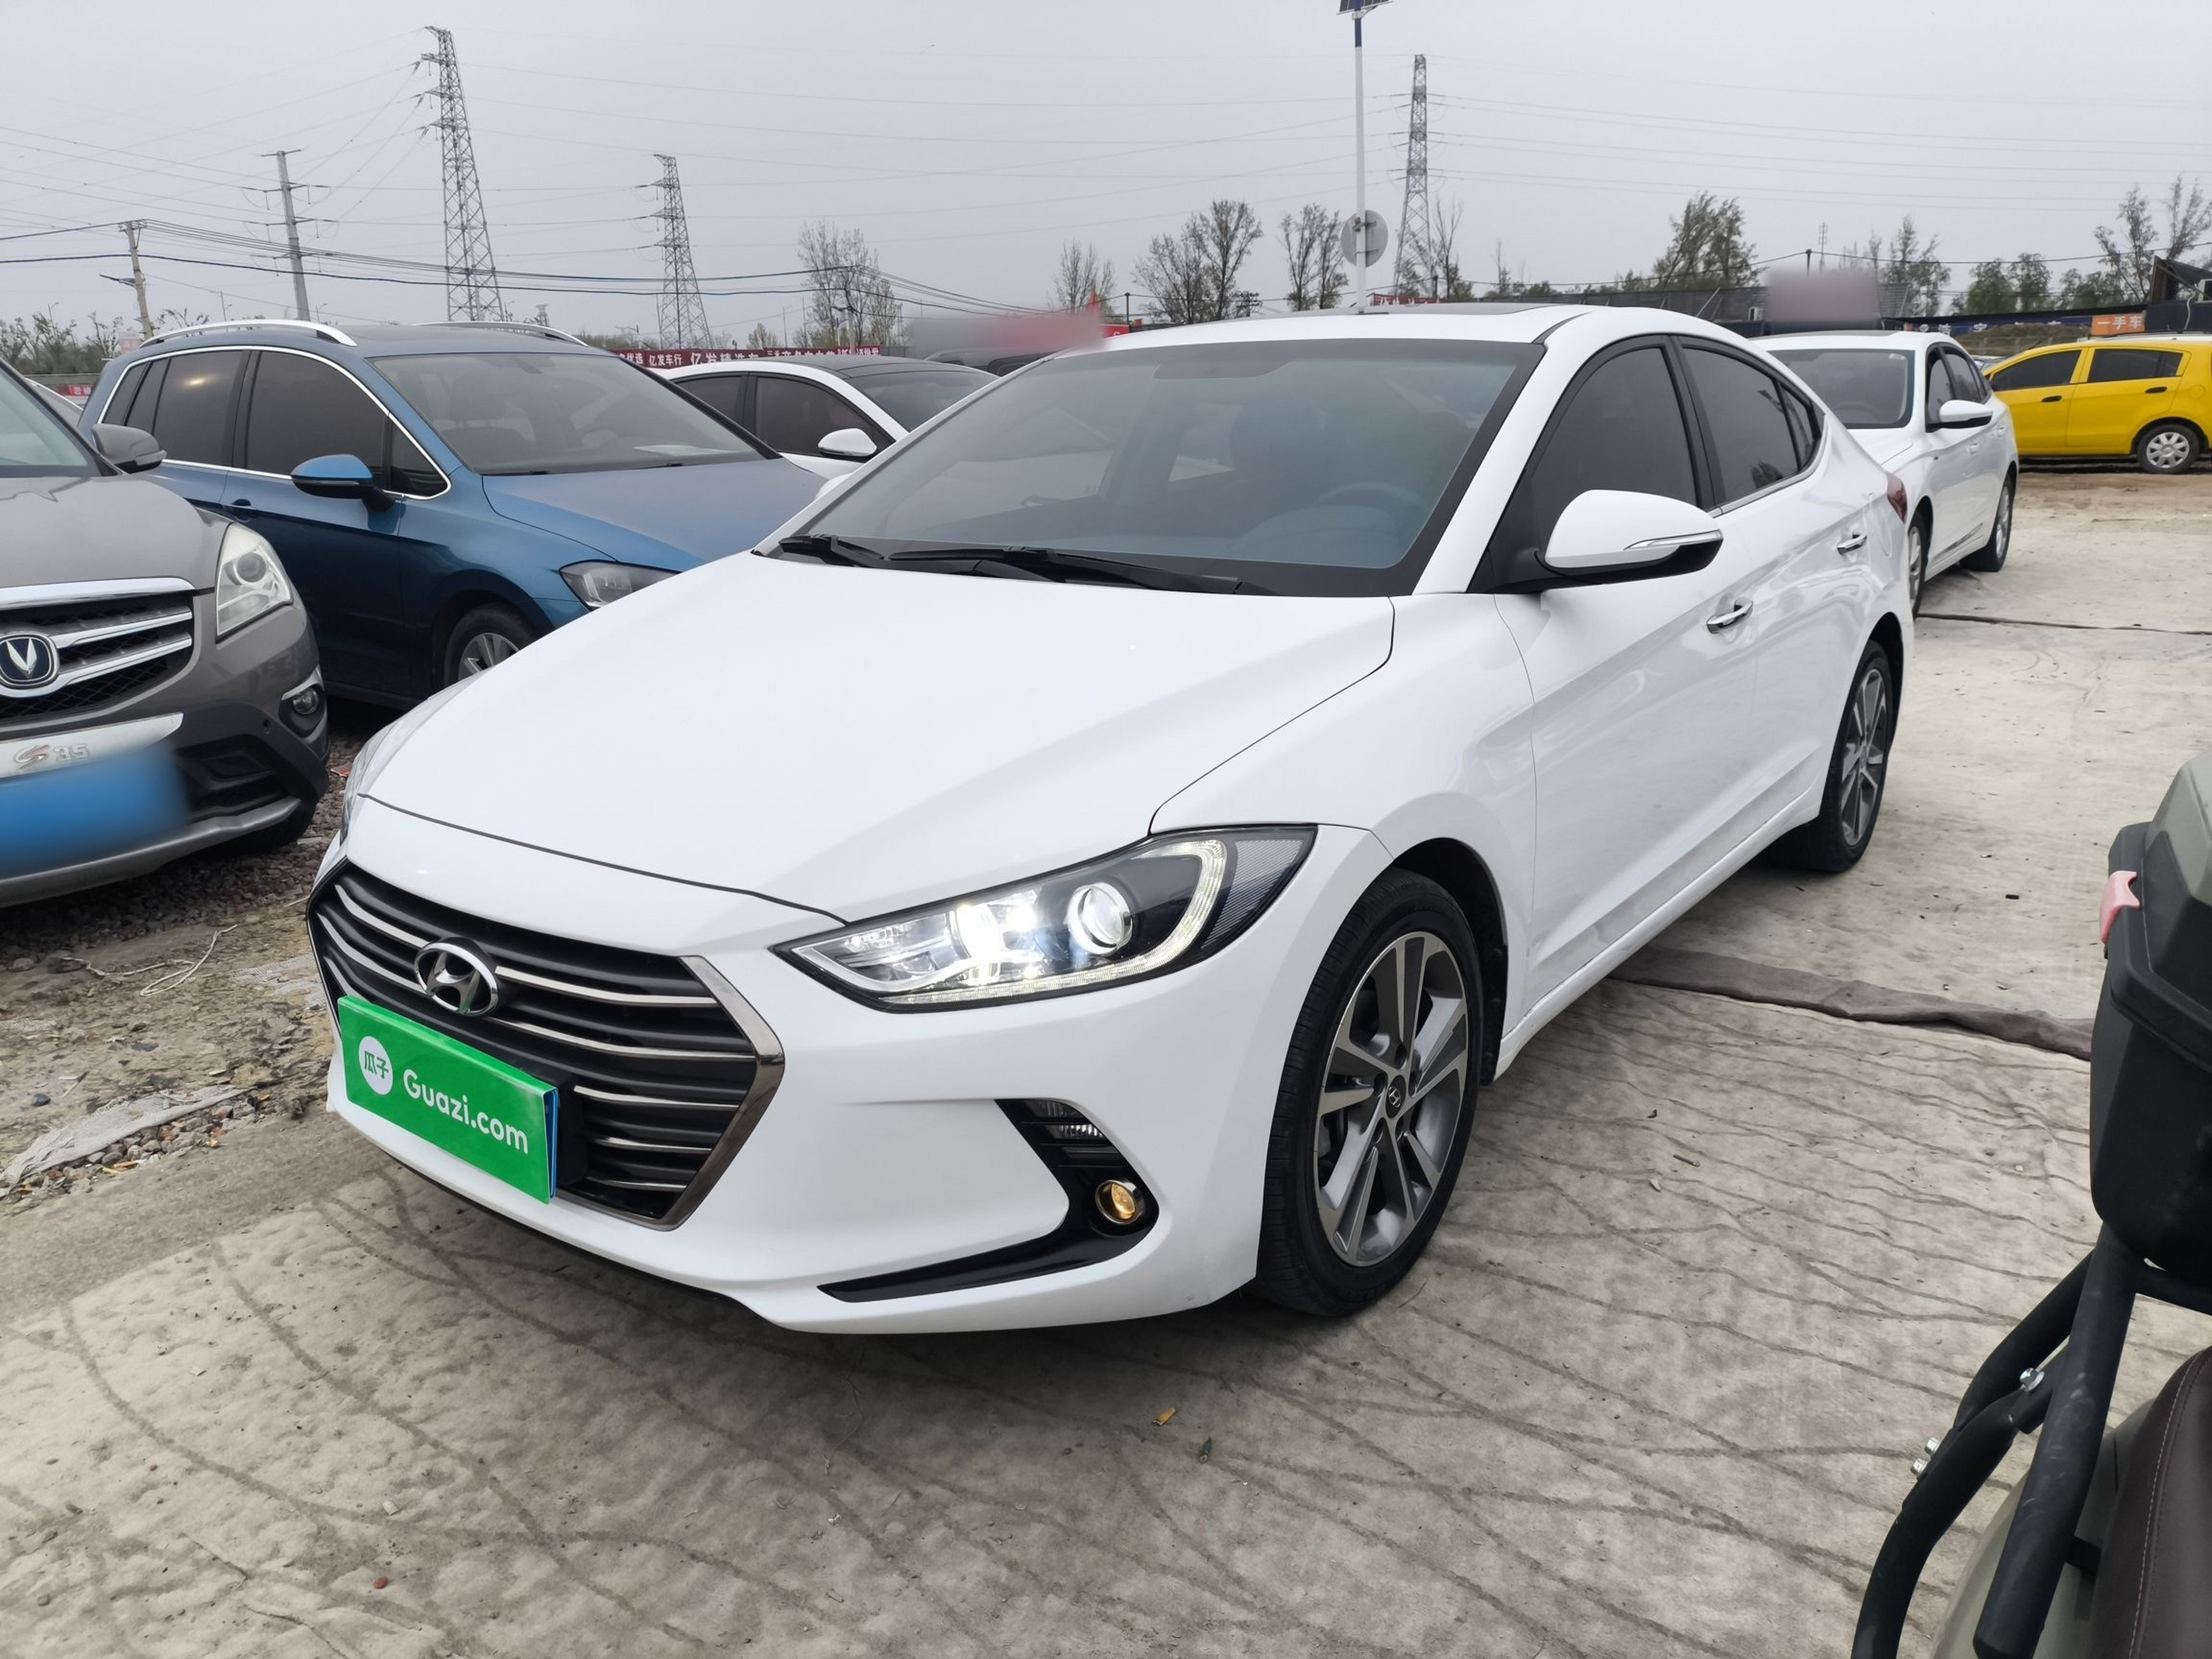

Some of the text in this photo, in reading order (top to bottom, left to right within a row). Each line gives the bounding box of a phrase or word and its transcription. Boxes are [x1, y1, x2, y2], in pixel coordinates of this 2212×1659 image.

[649, 354, 683, 366] 亿发车行
[364, 1050, 389, 1080] 瓜子
[403, 1069, 528, 1154] Guazi.com
